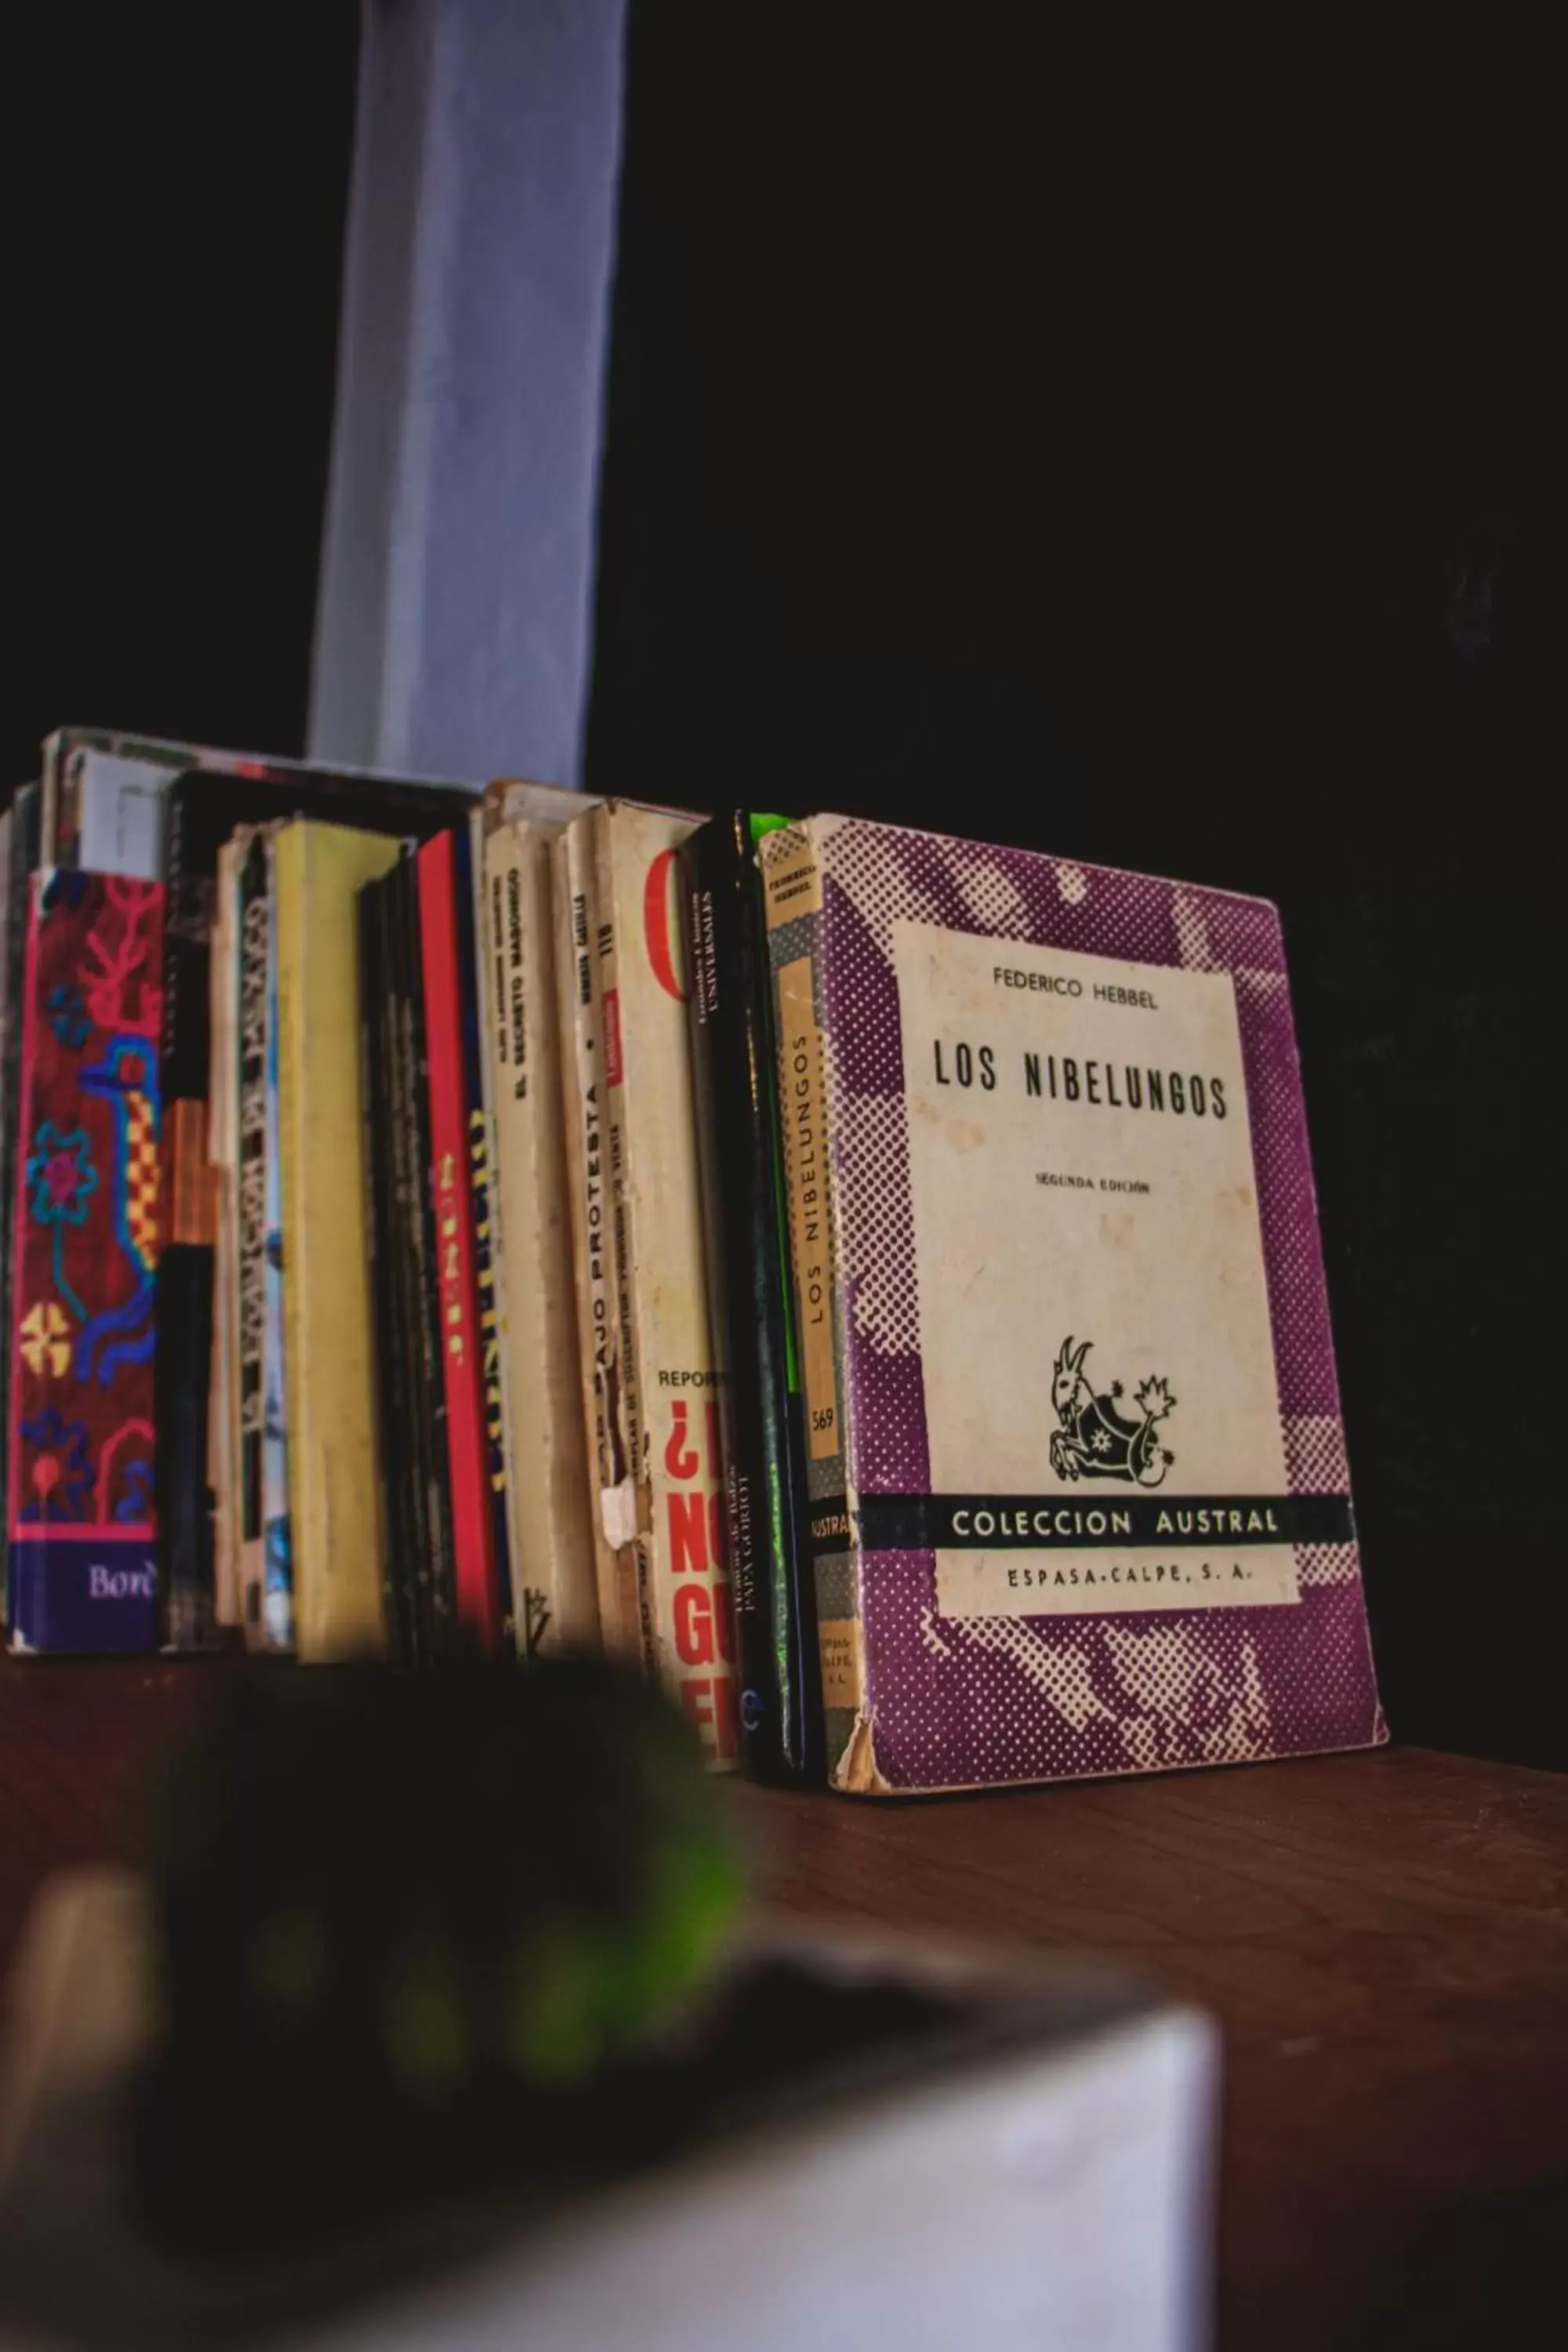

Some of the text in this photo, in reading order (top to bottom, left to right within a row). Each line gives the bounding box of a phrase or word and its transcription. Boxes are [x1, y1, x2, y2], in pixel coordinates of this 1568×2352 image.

[993, 967, 1159, 1010] FEDERICO HEBBEL
[934, 1039, 1226, 1120] LOS NIBELUNGOS
[586, 1085, 602, 1280] PROTESTA
[792, 1035, 823, 1325] LOS NIBELUNGOS
[1036, 1173, 1094, 1189] SEGUNDA
[812, 1408, 833, 1432] 569
[811, 1513, 849, 1539] AUSTRA
[951, 1508, 1279, 1537] COLECCION AUSTRAL
